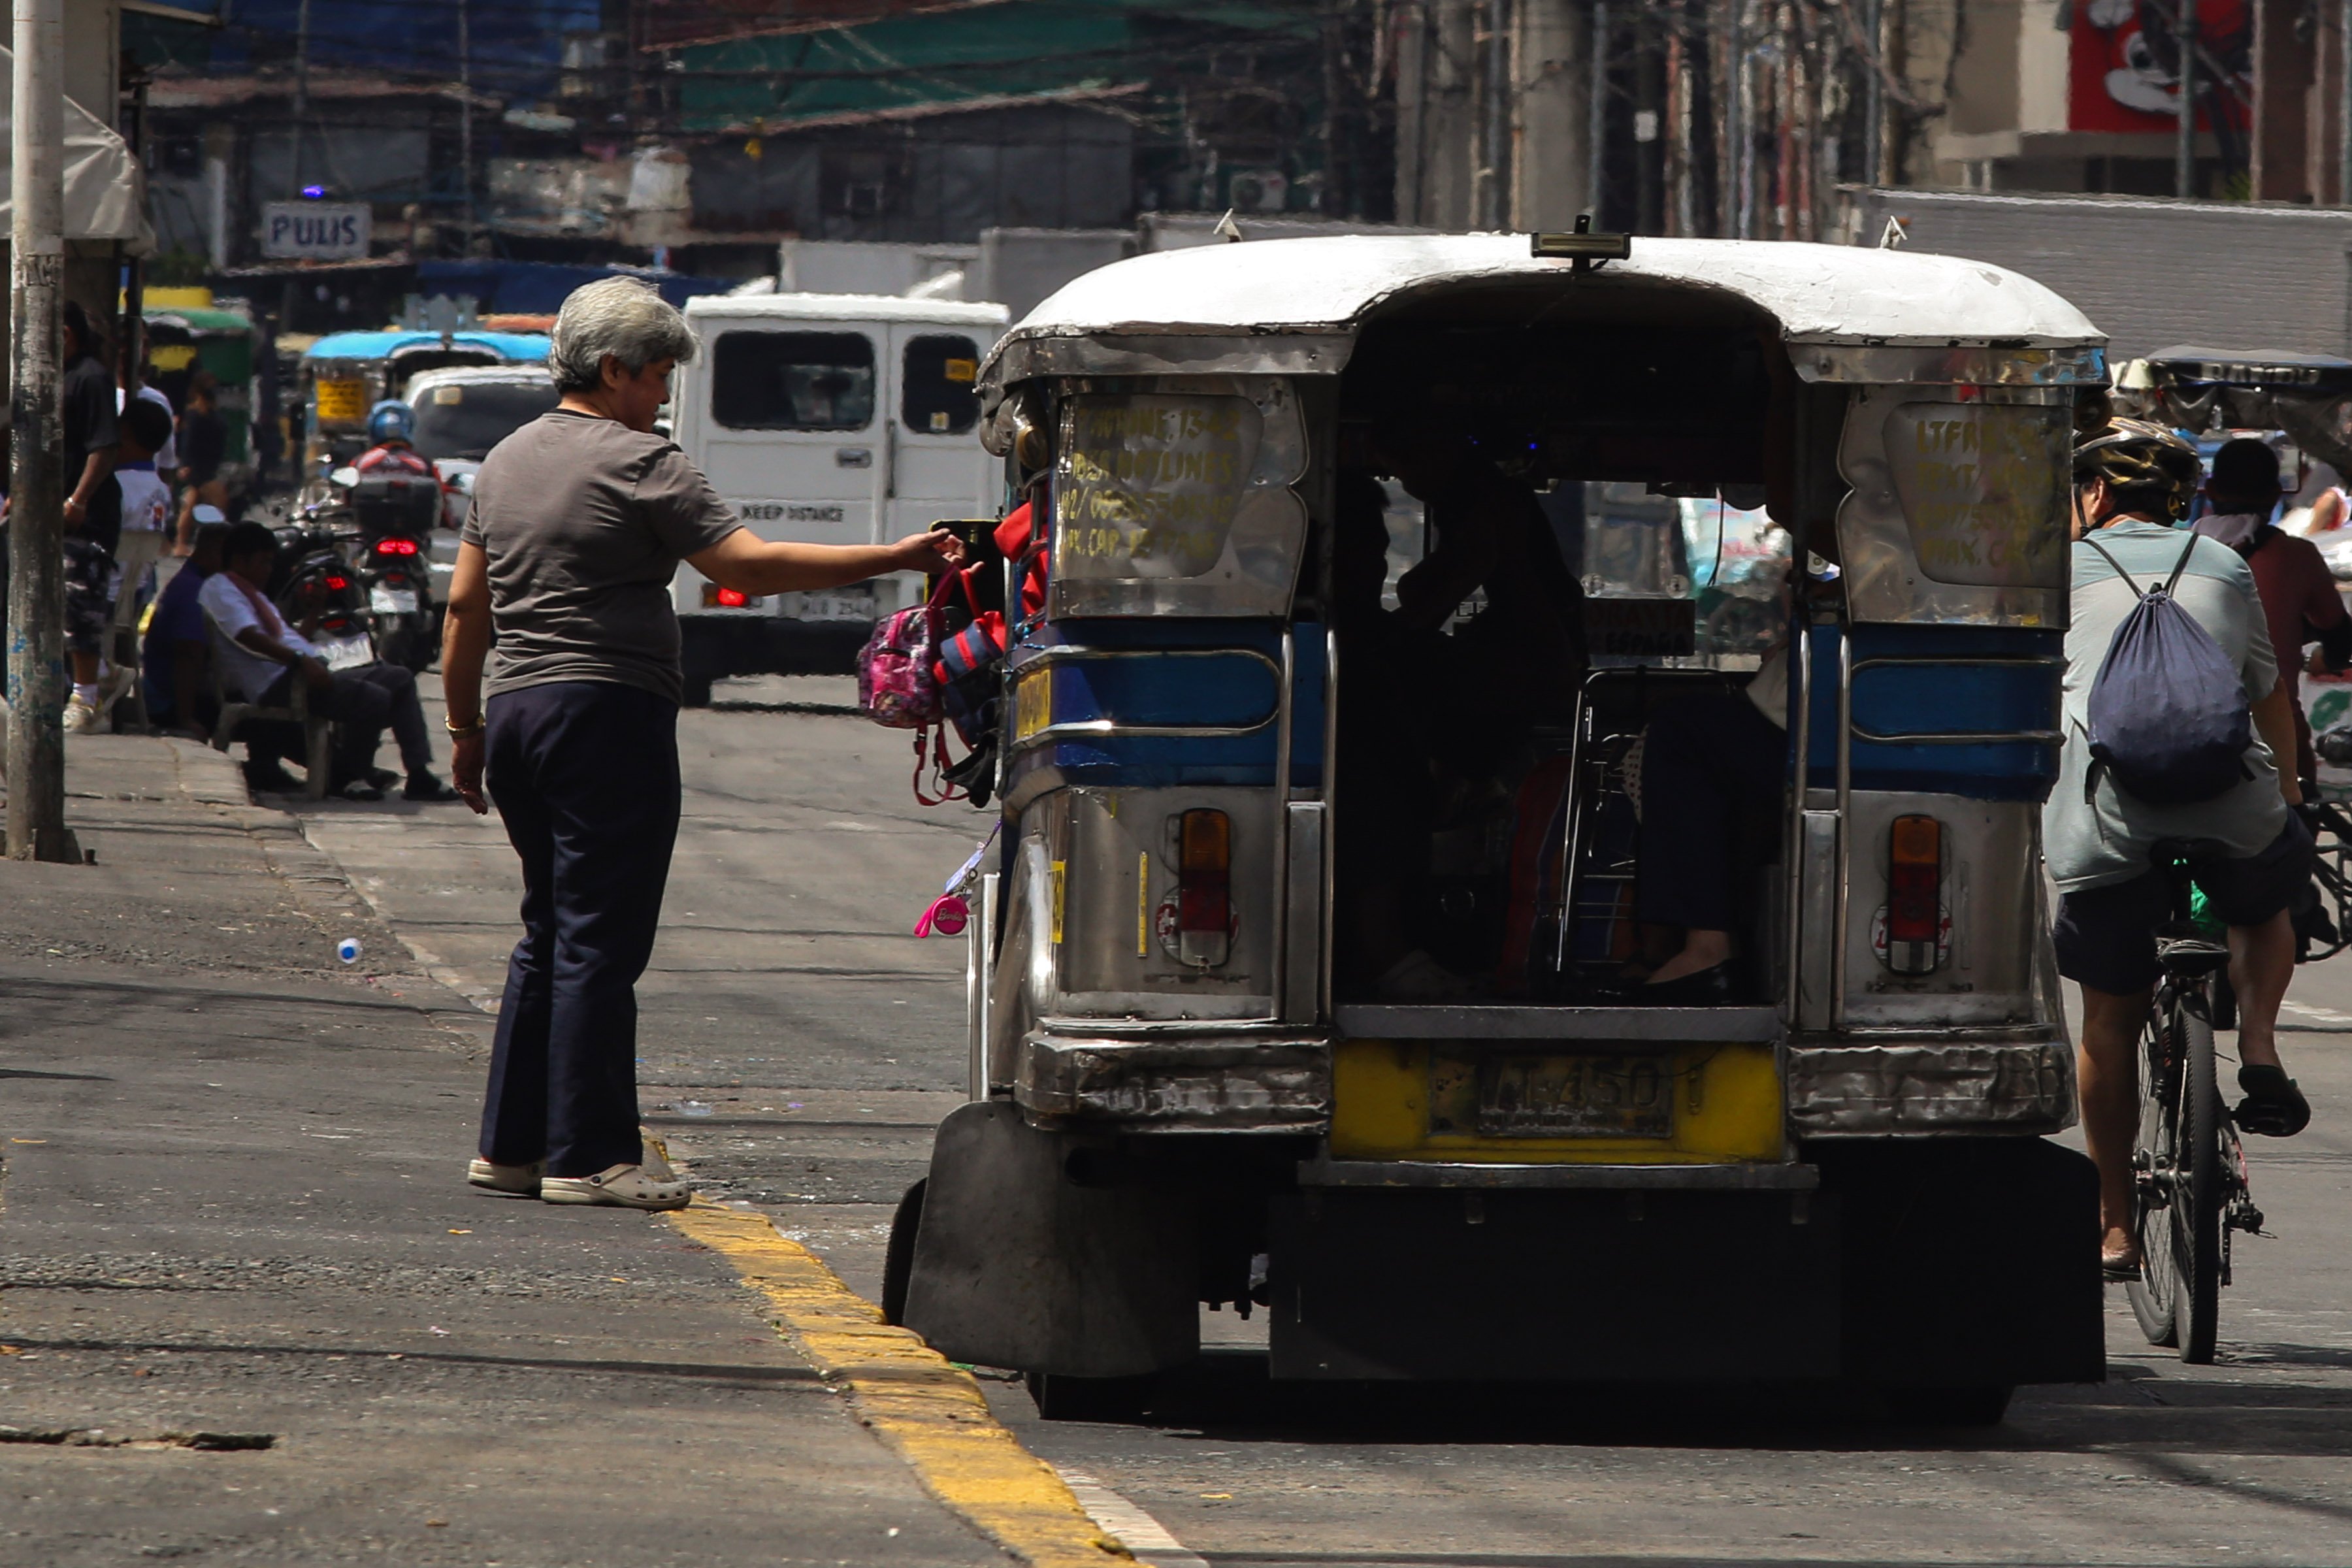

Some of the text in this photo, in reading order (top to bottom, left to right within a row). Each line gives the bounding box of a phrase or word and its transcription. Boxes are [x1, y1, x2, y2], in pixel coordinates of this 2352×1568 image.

[272, 215, 356, 246] PULIS
[742, 504, 783, 520] KEEP
[937, 907, 964, 922] Barbie
